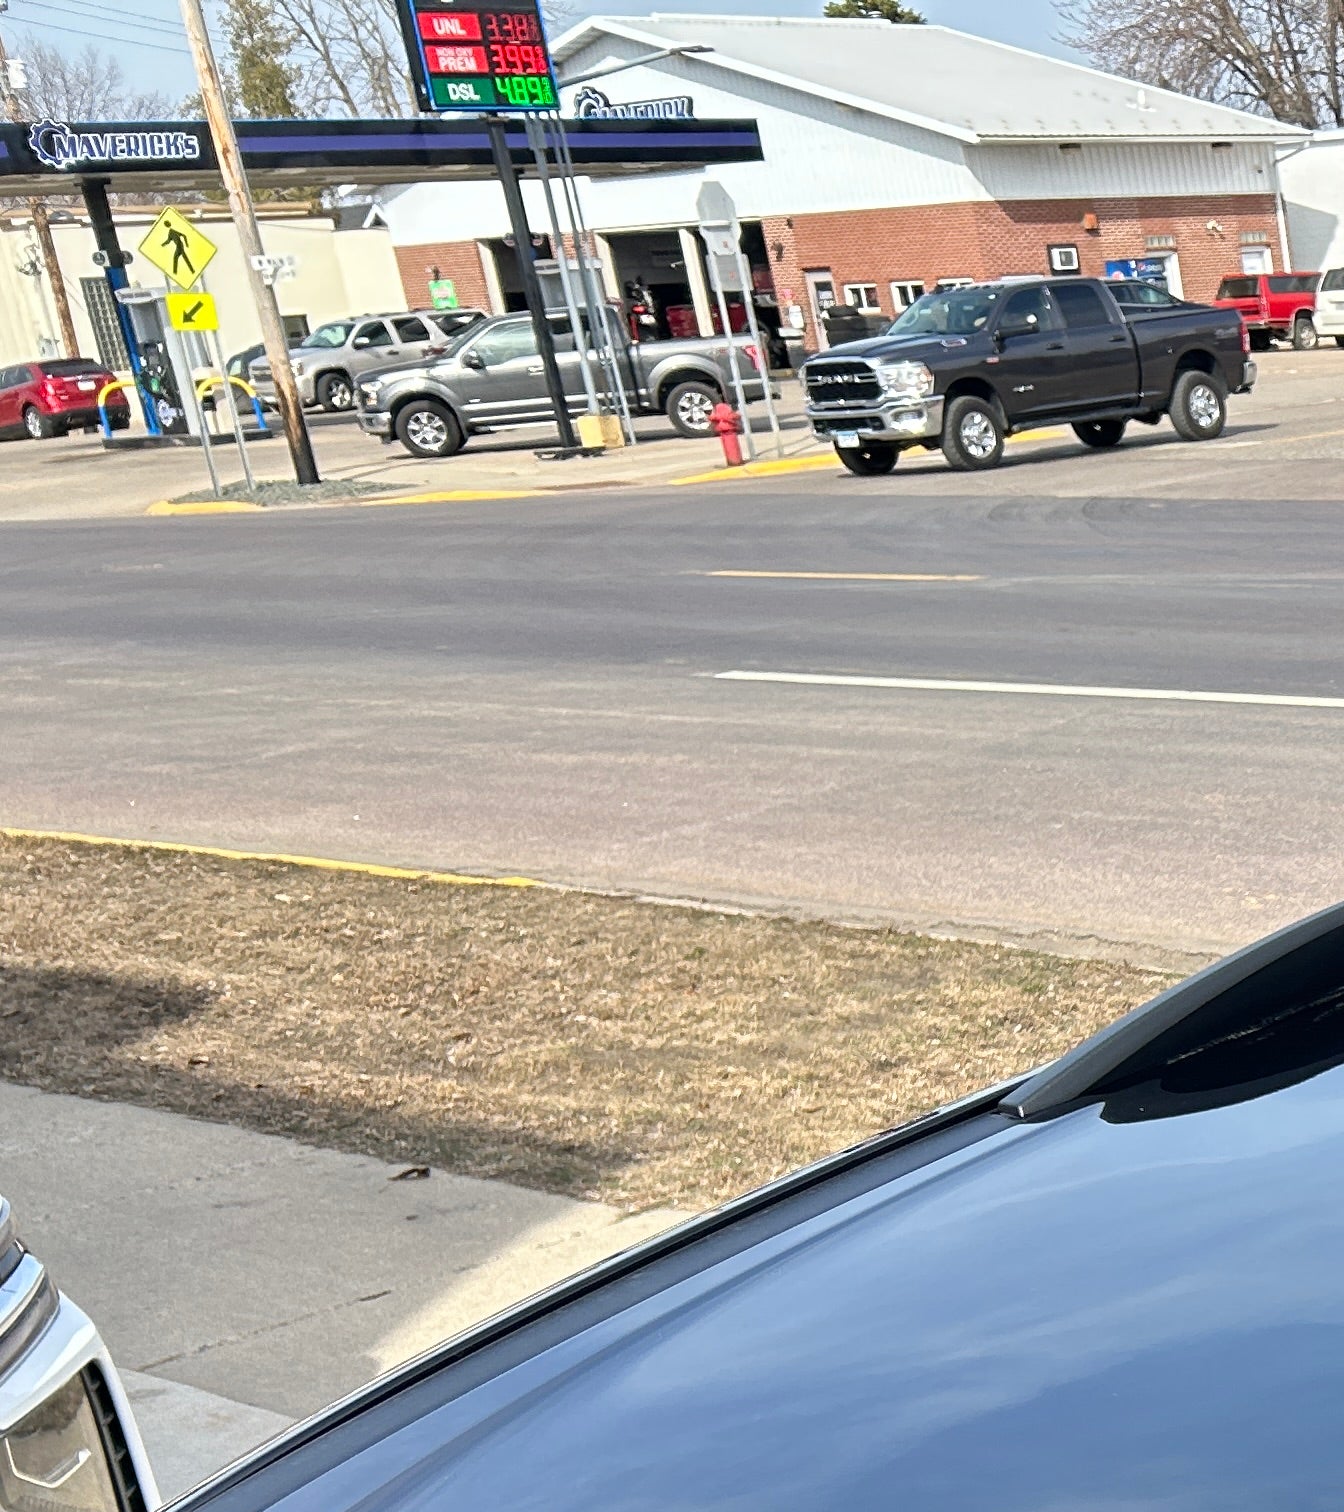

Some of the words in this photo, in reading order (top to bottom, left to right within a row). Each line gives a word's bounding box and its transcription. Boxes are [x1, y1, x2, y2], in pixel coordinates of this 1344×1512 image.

[432, 16, 467, 36] UNL
[438, 57, 478, 72] PREM
[447, 82, 481, 101] DSL
